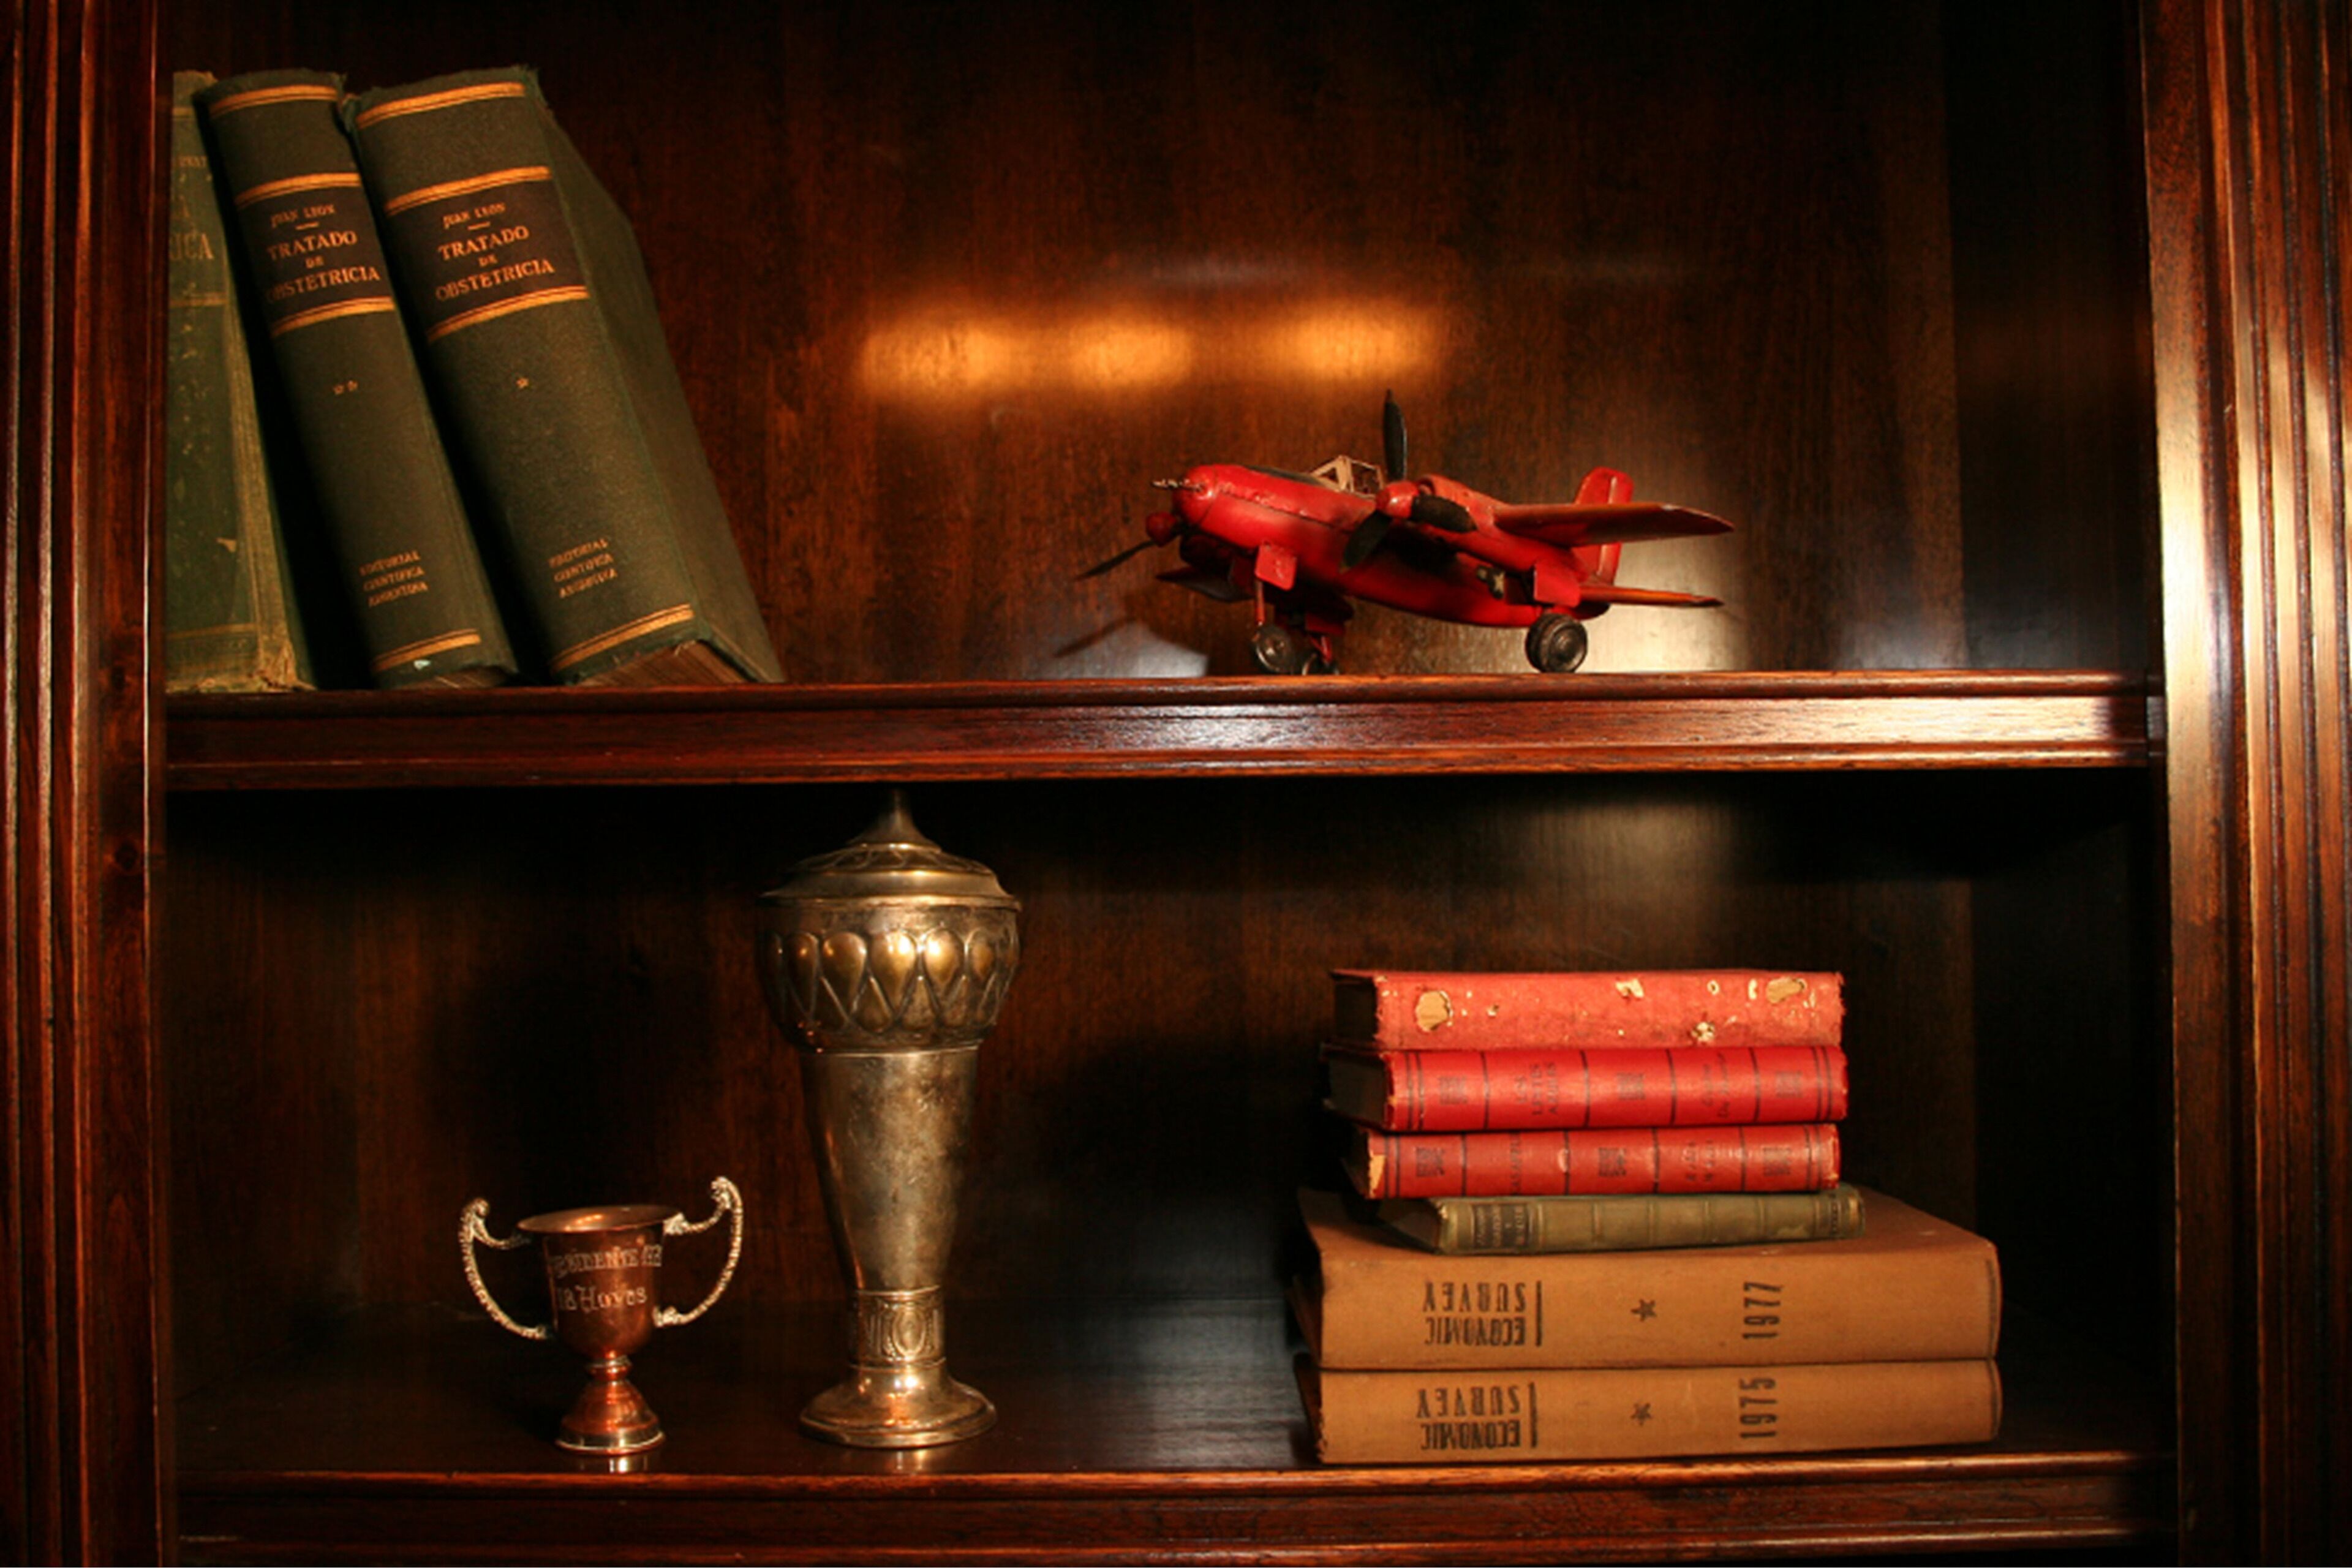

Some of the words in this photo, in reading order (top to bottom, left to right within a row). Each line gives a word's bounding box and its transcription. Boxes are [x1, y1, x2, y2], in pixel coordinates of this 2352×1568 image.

[270, 209, 298, 228] JUAN
[442, 211, 470, 229] JUAN
[266, 230, 357, 260] TRATADO
[437, 225, 529, 261] TRATADO
[304, 255, 324, 269] DE
[478, 254, 499, 267] DE
[265, 265, 380, 303] OBSTETRICIA
[435, 259, 555, 301] OBSTETRICIA
[1422, 1282, 1526, 1313] SURVEY
[1743, 1280, 1783, 1340] 1977
[1425, 1317, 1525, 1346] ECONOMIC
[1417, 1386, 1520, 1419] SURVEY
[1739, 1375, 1777, 1439] 1975
[1420, 1420, 1521, 1451] ECONOMIC
